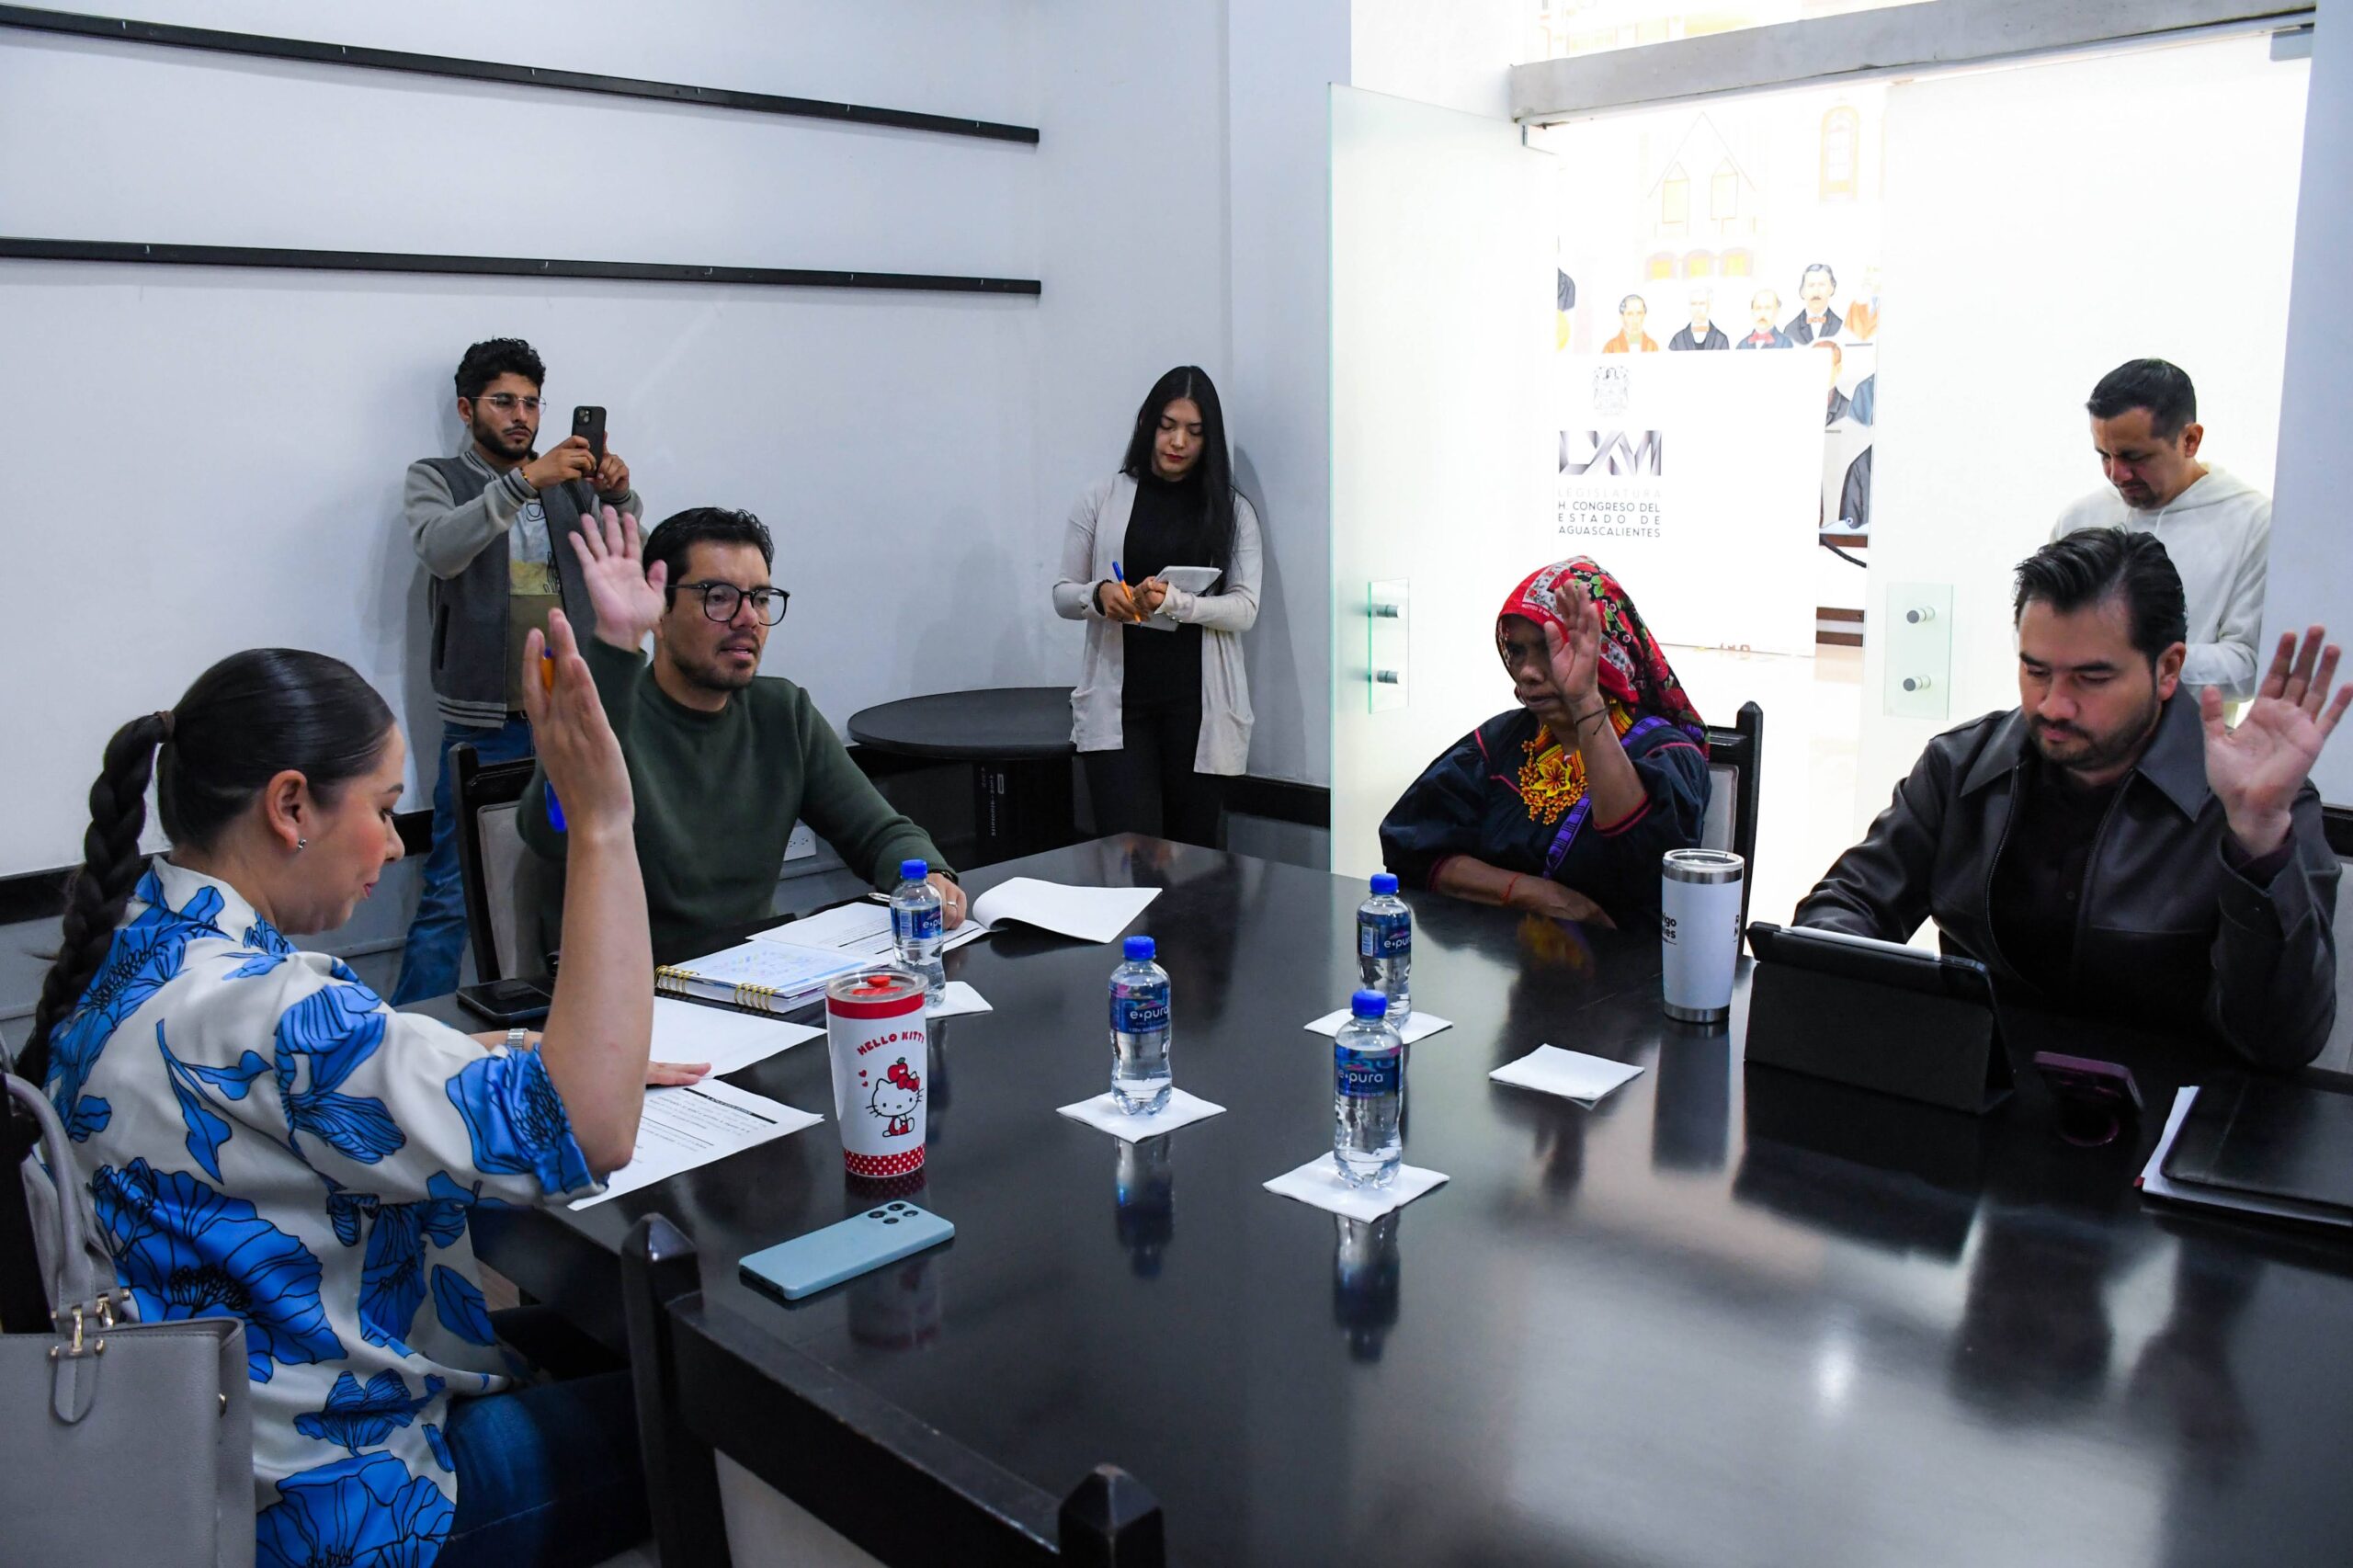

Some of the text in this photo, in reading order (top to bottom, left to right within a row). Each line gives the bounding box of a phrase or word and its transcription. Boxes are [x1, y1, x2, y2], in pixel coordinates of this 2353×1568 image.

[1558, 488, 1661, 499] LEGISLATURA
[1573, 502, 1635, 512] CONGRESO
[1640, 504, 1660, 513] DEL
[1558, 513, 1661, 525] ESTADO DE
[1559, 526, 1661, 538] AGUASCALIENTES
[857, 1033, 898, 1055] HELLO
